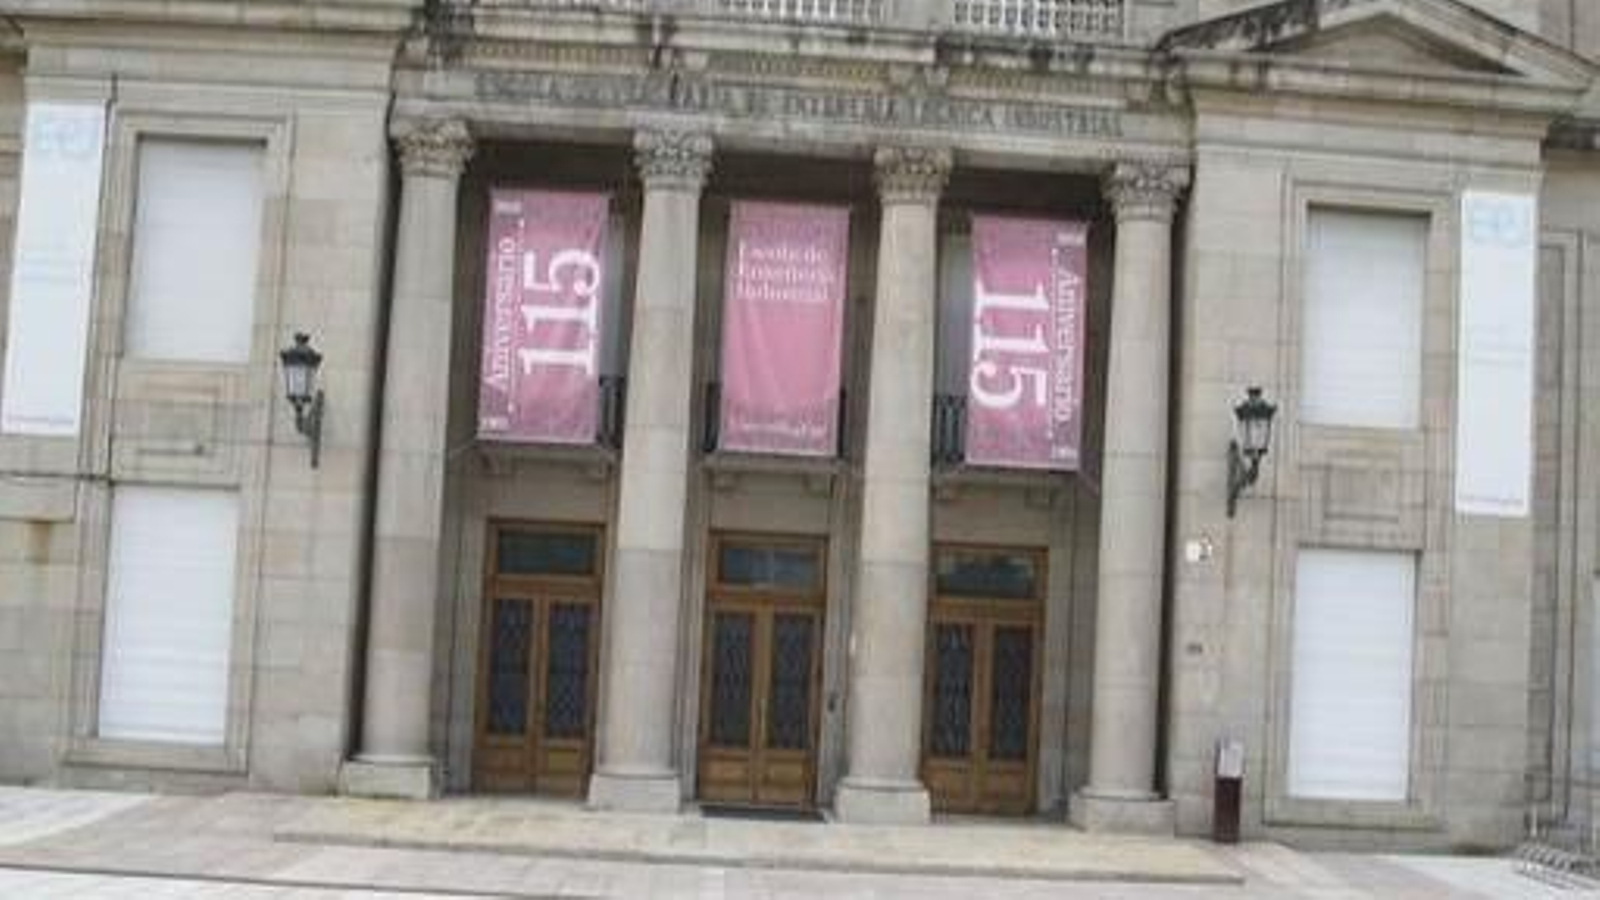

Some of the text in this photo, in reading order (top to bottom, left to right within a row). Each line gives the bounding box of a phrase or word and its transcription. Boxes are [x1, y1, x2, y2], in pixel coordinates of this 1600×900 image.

[484, 237, 517, 392] Aniversario
[518, 249, 600, 375] 115
[970, 278, 1050, 409] 115
[1053, 268, 1081, 422] Aniversario
